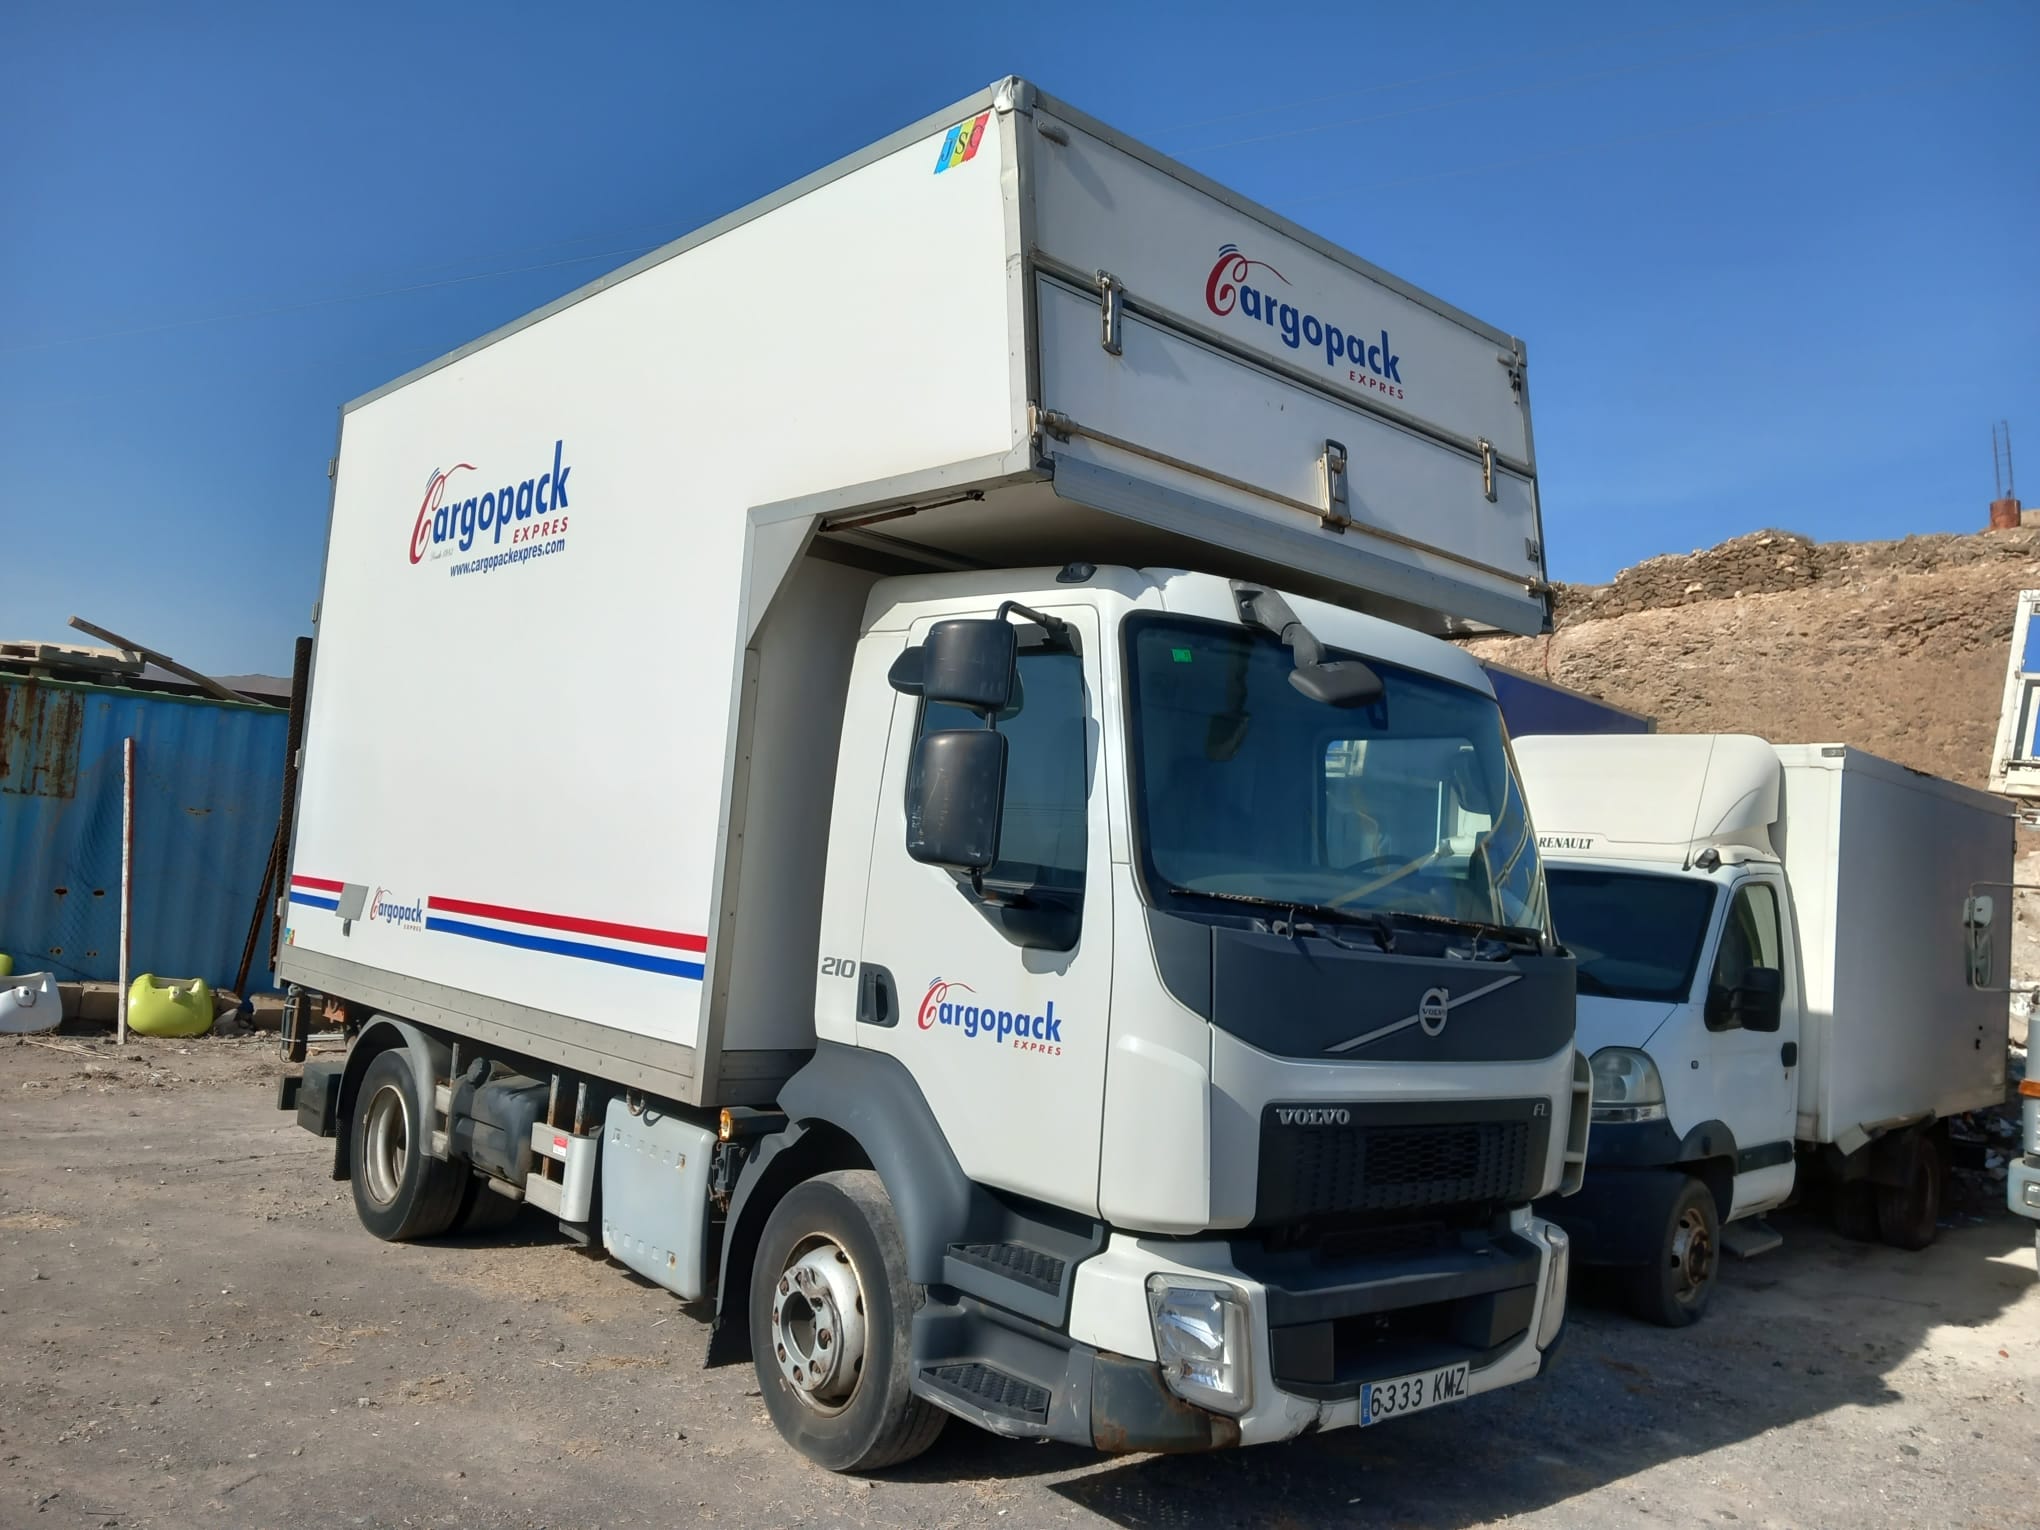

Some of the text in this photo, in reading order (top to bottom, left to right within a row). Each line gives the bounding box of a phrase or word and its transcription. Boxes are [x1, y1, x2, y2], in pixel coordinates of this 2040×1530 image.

[1205, 243, 1401, 384] Cargopack
[1349, 370, 1404, 400] EXPRES
[409, 439, 571, 565] Cargopack
[512, 516, 569, 544] EXPRES
[450, 538, 565, 577] www.cargopackexpres.com
[1538, 836, 1594, 850] RENAULT
[369, 886, 422, 926] Cargopack
[821, 956, 857, 979] 210
[917, 976, 1062, 1043] Cargopack
[1013, 1039, 1062, 1056] EXPRES
[1275, 1108, 1351, 1125] VOLVO
[1371, 1378, 1424, 1417] 6333
[1432, 1366, 1466, 1403] KMZ
